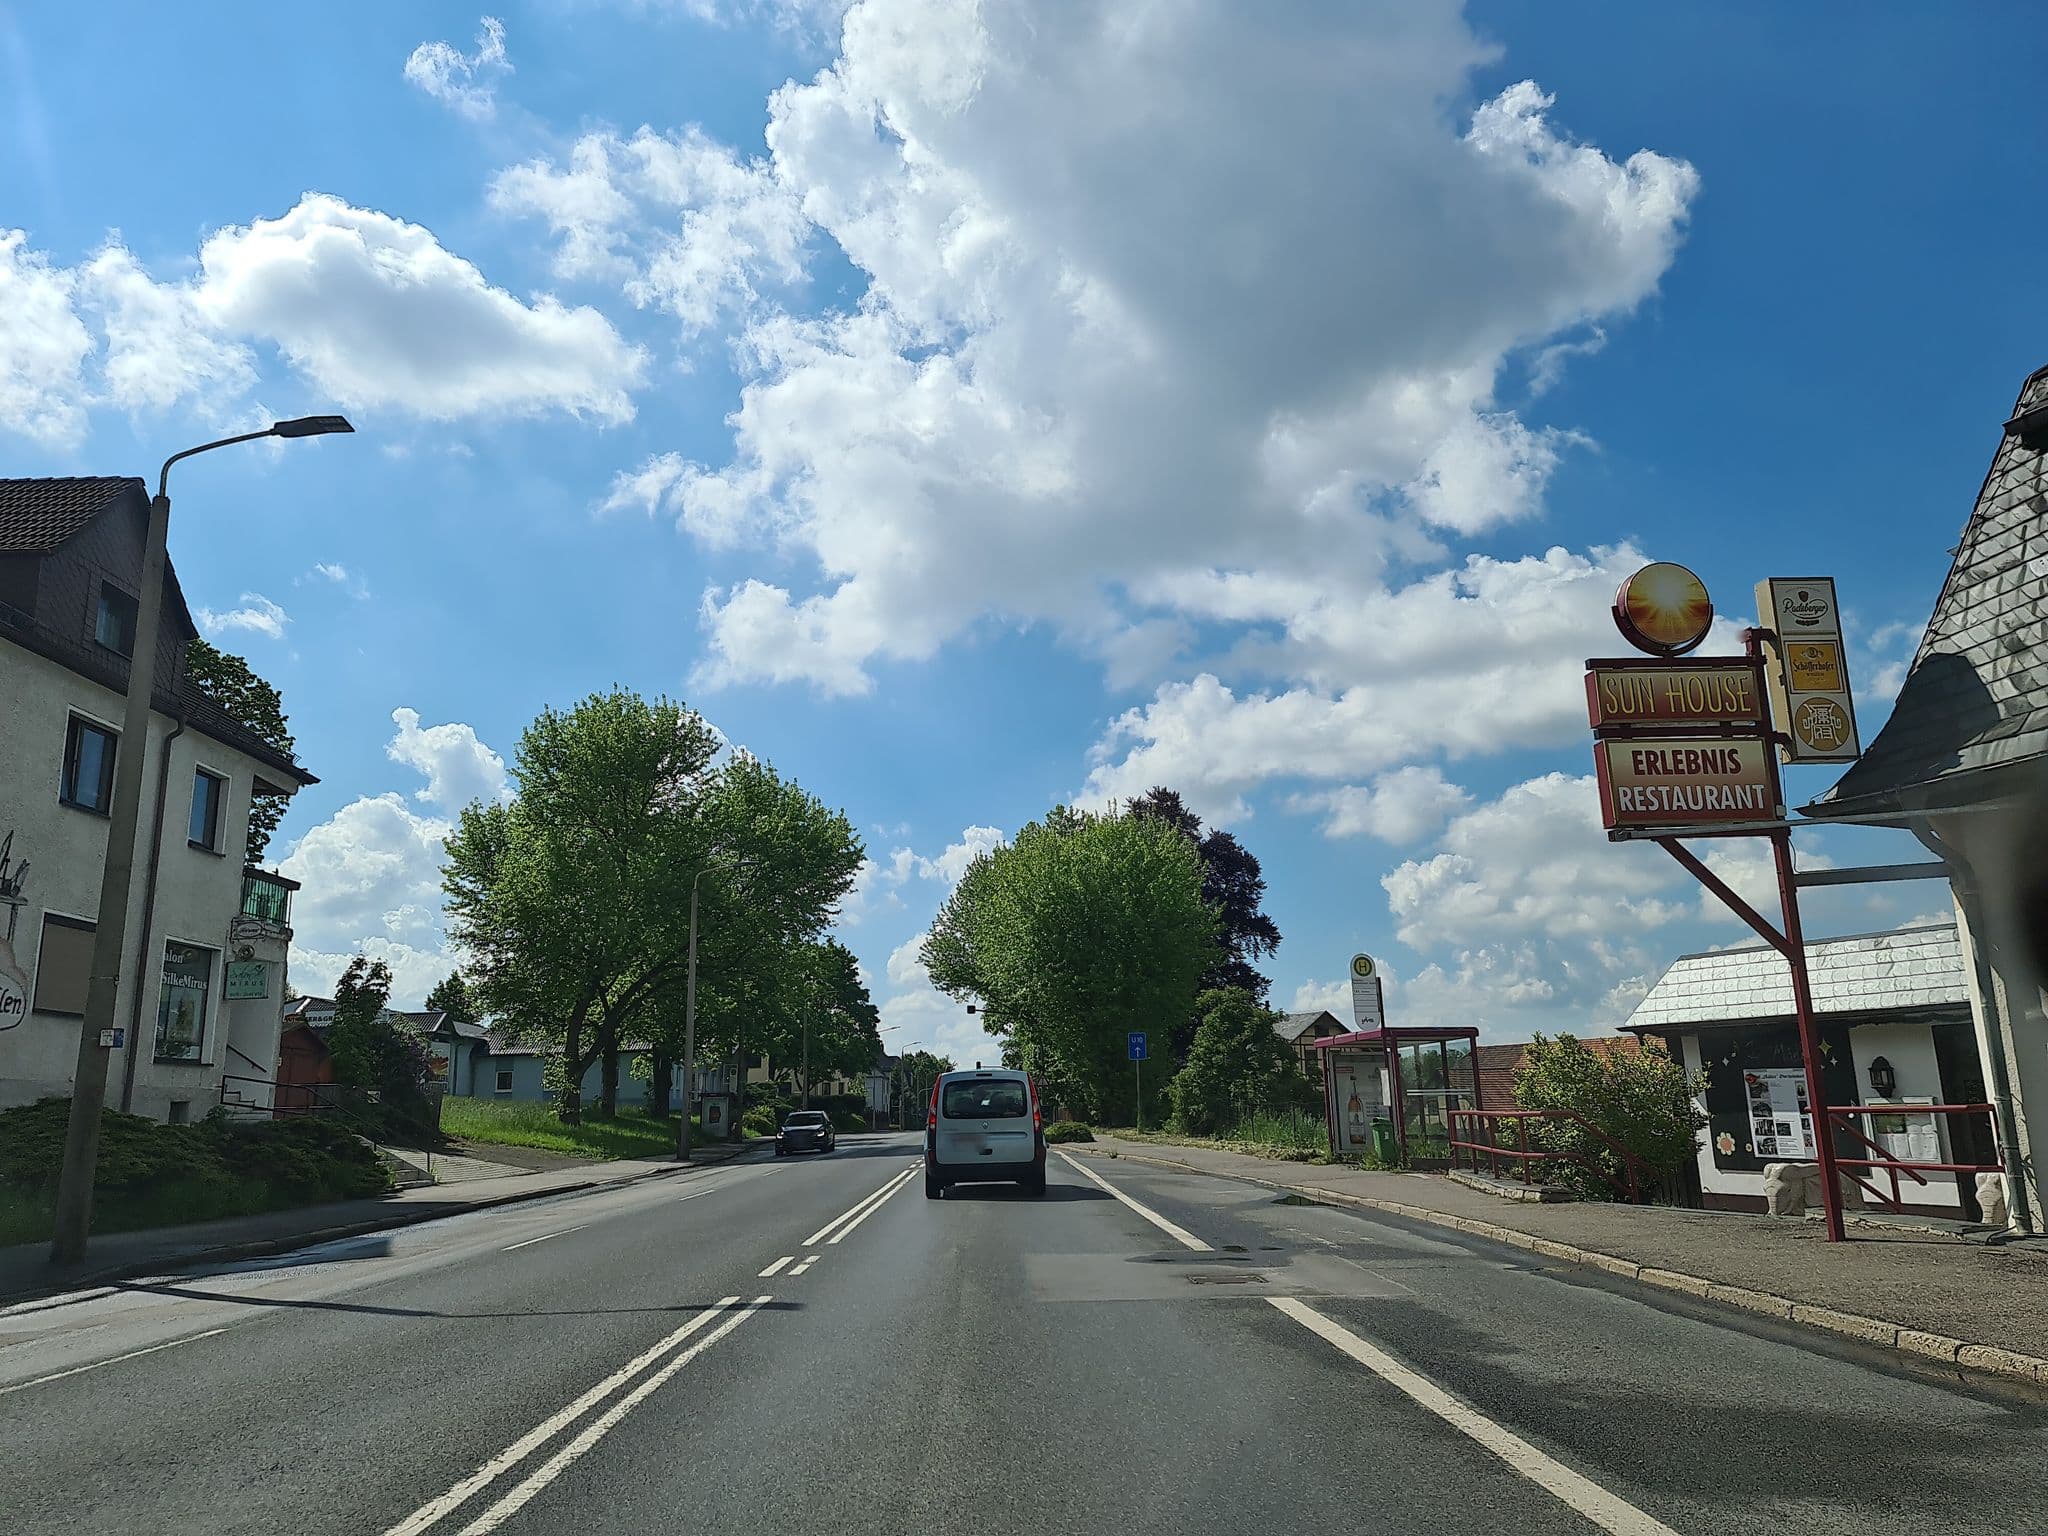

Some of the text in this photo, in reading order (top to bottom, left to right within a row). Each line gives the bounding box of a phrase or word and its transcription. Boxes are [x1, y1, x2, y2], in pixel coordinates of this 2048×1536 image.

[1606, 675, 1751, 714] SUN HOUSE
[1631, 749, 1742, 776] ERLEBNIS
[1618, 784, 1766, 812] RESTAURANT
[1358, 961, 1367, 972] H
[183, 975, 208, 990] Mirus
